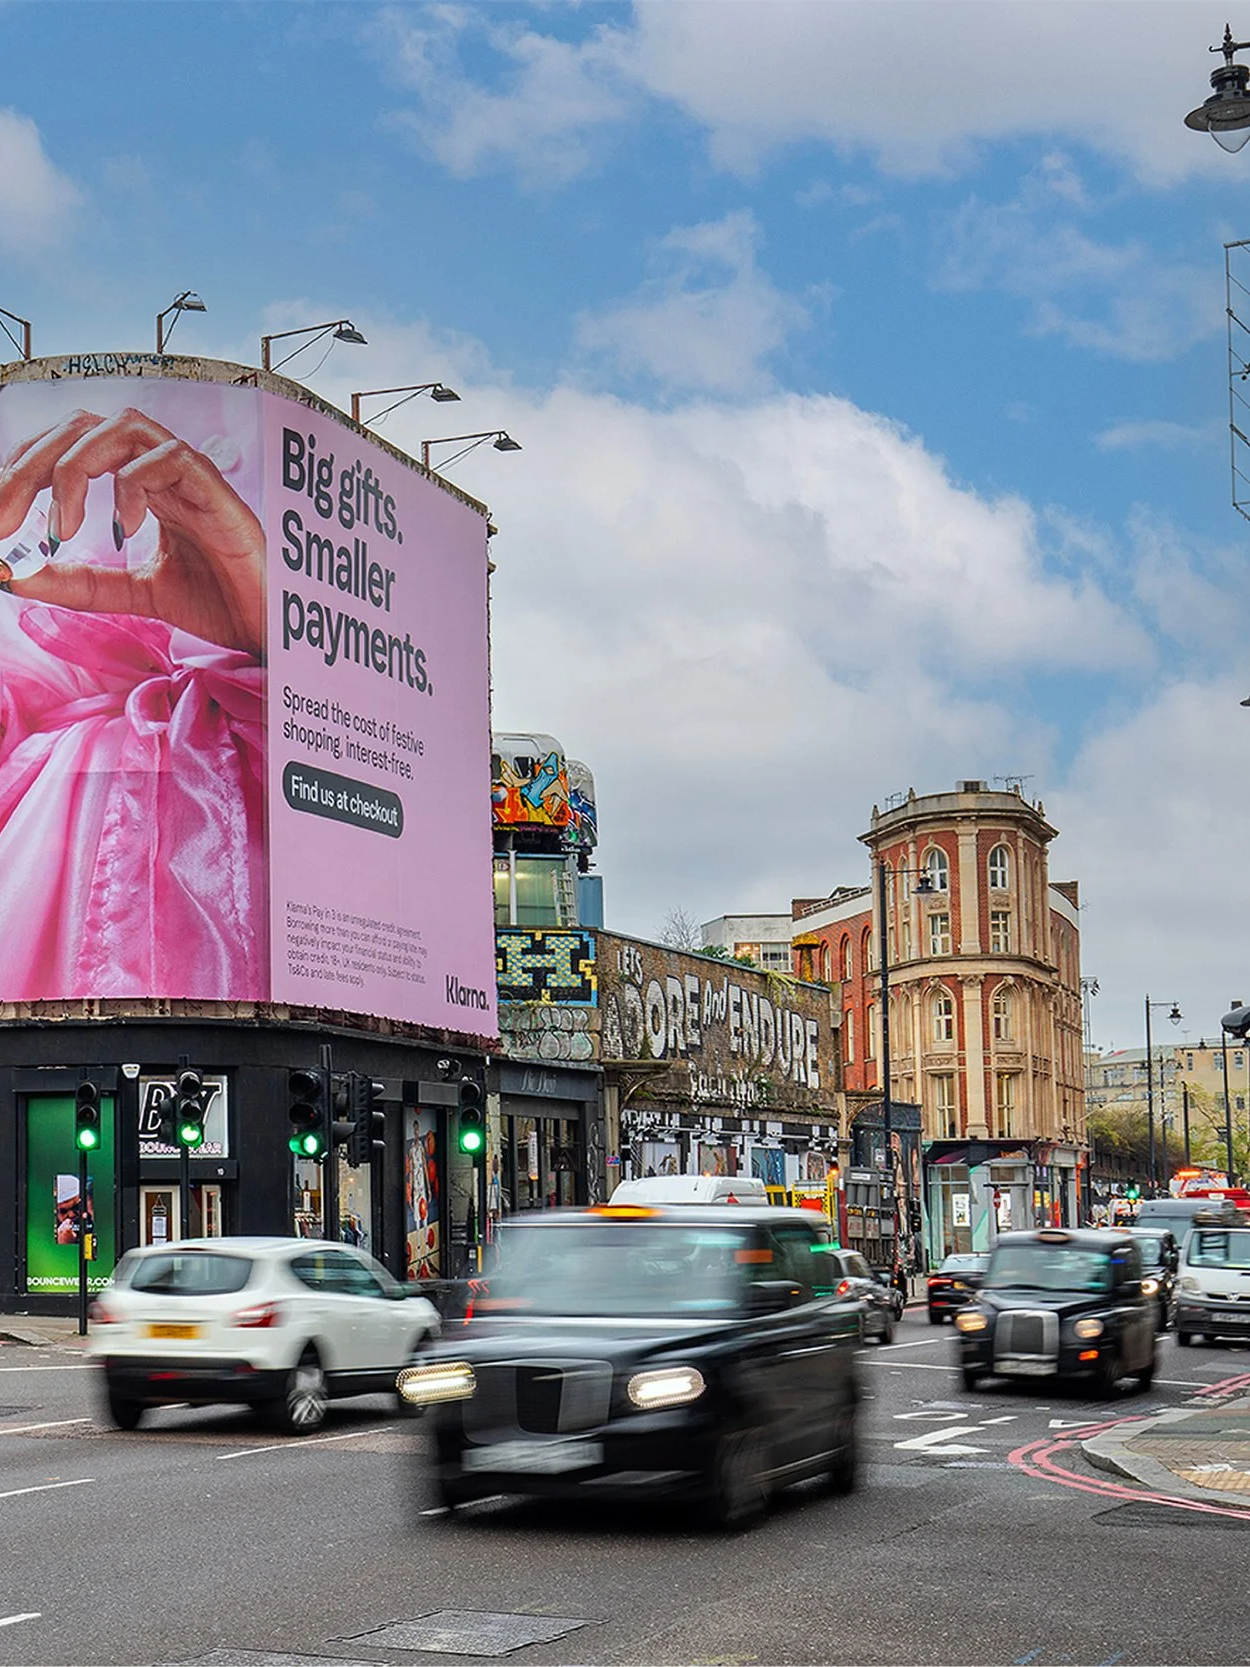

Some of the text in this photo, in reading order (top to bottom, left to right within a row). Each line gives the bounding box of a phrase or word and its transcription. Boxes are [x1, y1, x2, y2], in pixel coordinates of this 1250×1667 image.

[282, 426, 403, 545] Big gifts.
[282, 509, 395, 612] Smaller
[282, 589, 433, 697] payments.
[283, 685, 425, 757] Spread the cost of festive
[283, 717, 414, 781] shopping, interest-free.
[291, 775, 399, 827] Find us at checkout
[445, 974, 490, 1011] Klarna.
[728, 984, 820, 1090] ENDURE
